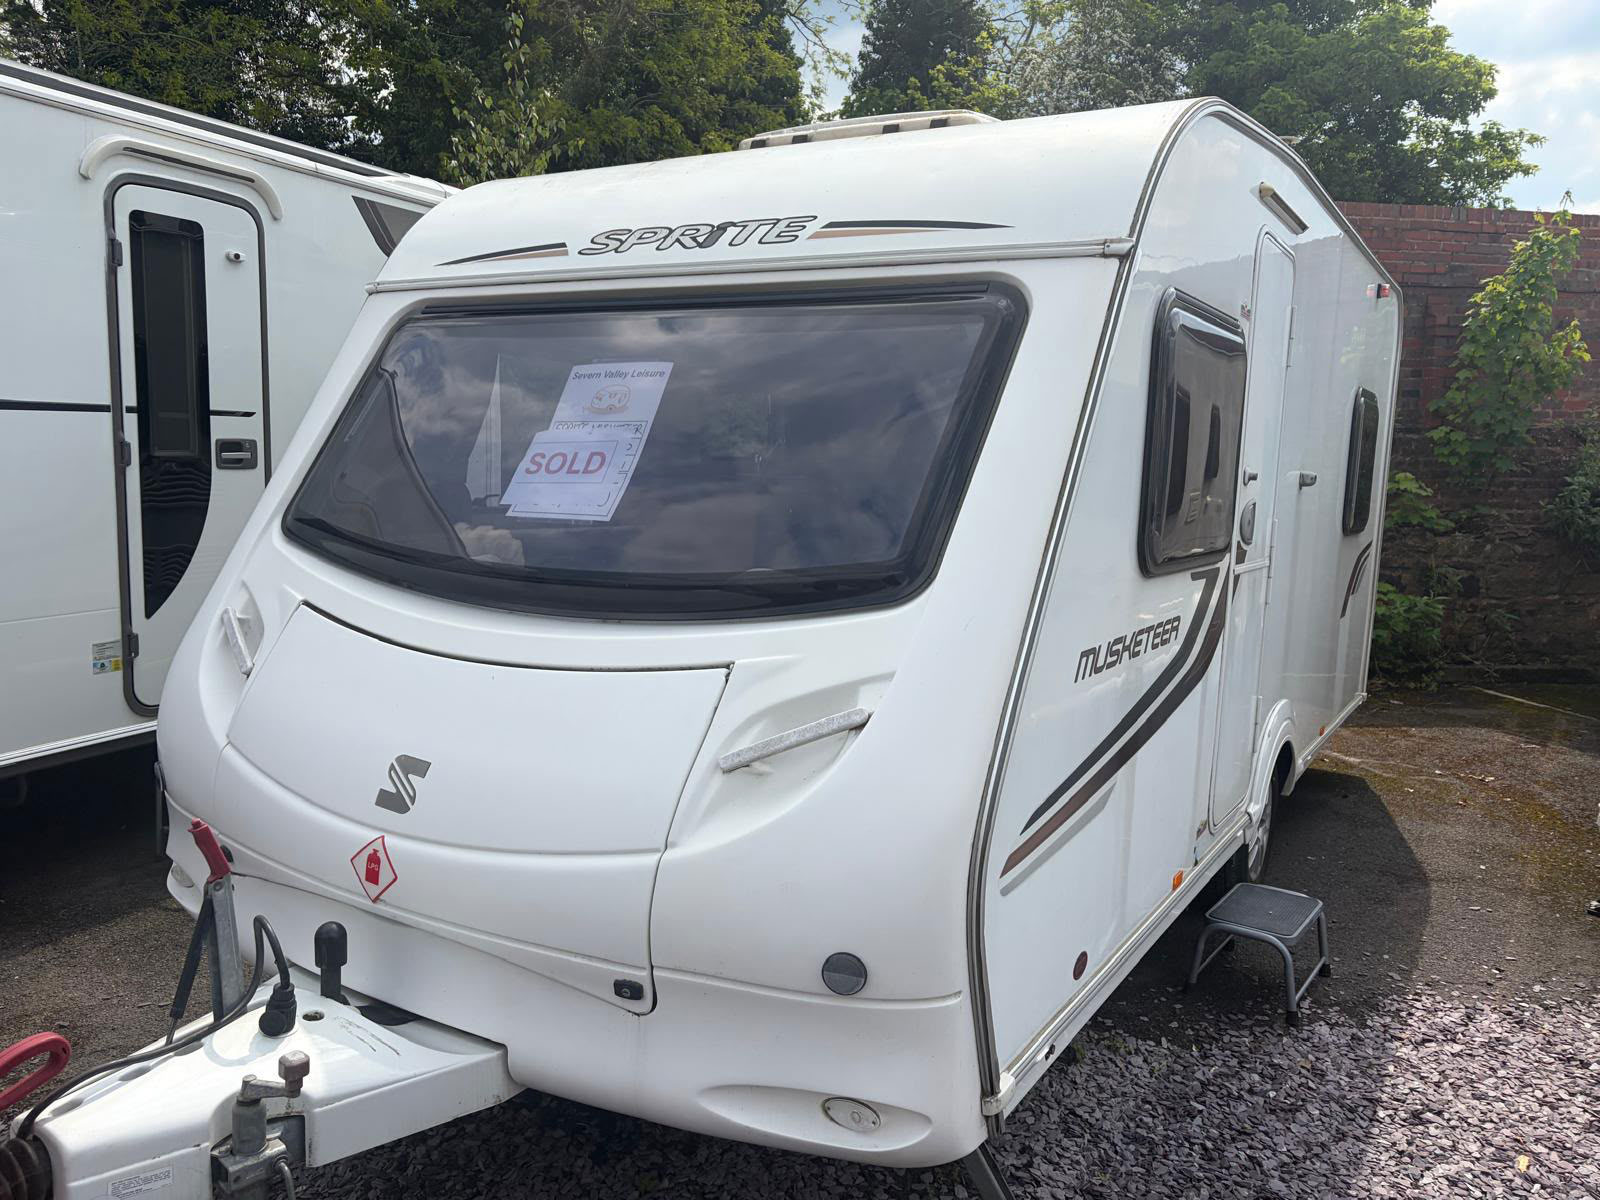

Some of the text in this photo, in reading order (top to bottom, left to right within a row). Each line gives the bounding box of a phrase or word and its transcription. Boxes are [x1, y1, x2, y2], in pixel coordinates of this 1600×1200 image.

[572, 368, 665, 380] Severn Valley Leisure
[525, 451, 607, 475] SOLD
[1074, 615, 1181, 683] MUSKETEER
